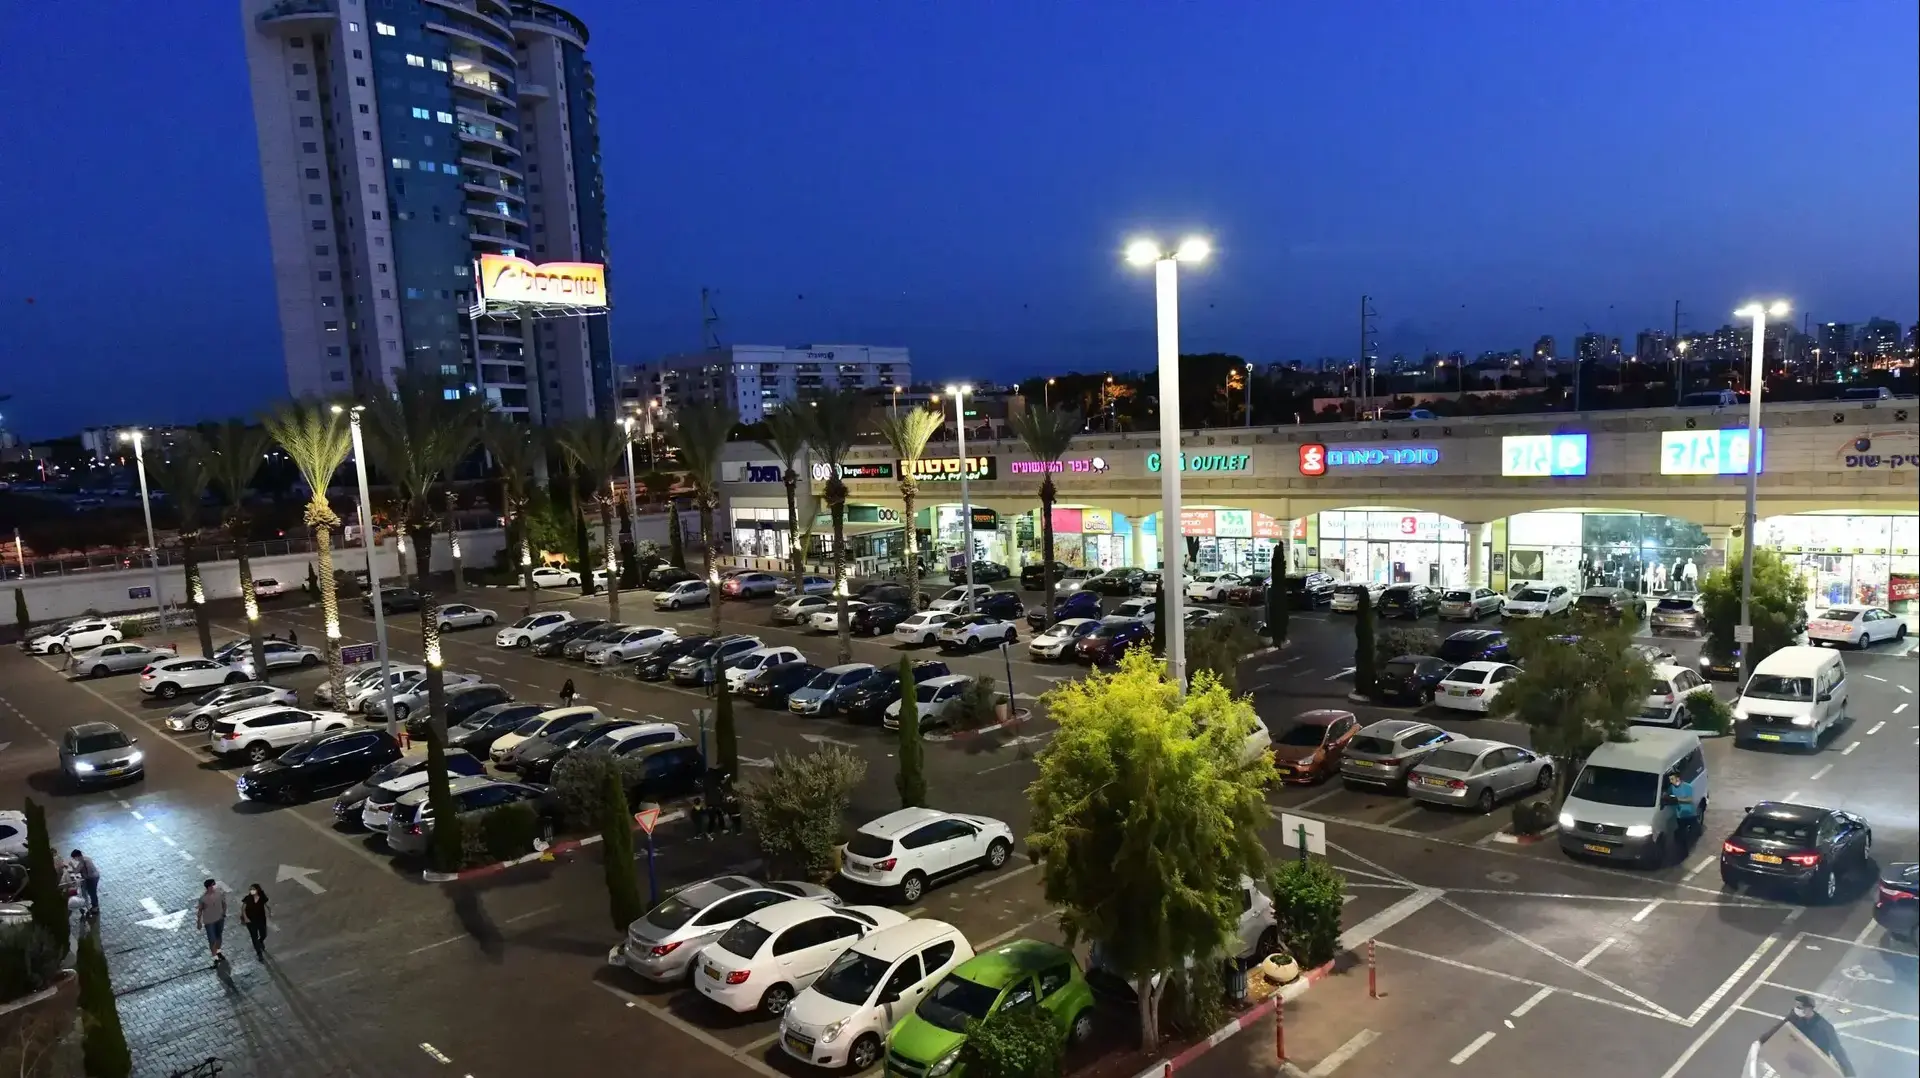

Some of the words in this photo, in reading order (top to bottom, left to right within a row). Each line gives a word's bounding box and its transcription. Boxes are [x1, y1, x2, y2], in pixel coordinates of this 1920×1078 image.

[520, 268, 597, 294] שופרסל
[1147, 452, 1186, 472] Gi
[1191, 455, 1250, 471] OUTLET
[1327, 448, 1439, 465] סופר-פארם
[1068, 460, 1091, 472] כפר
